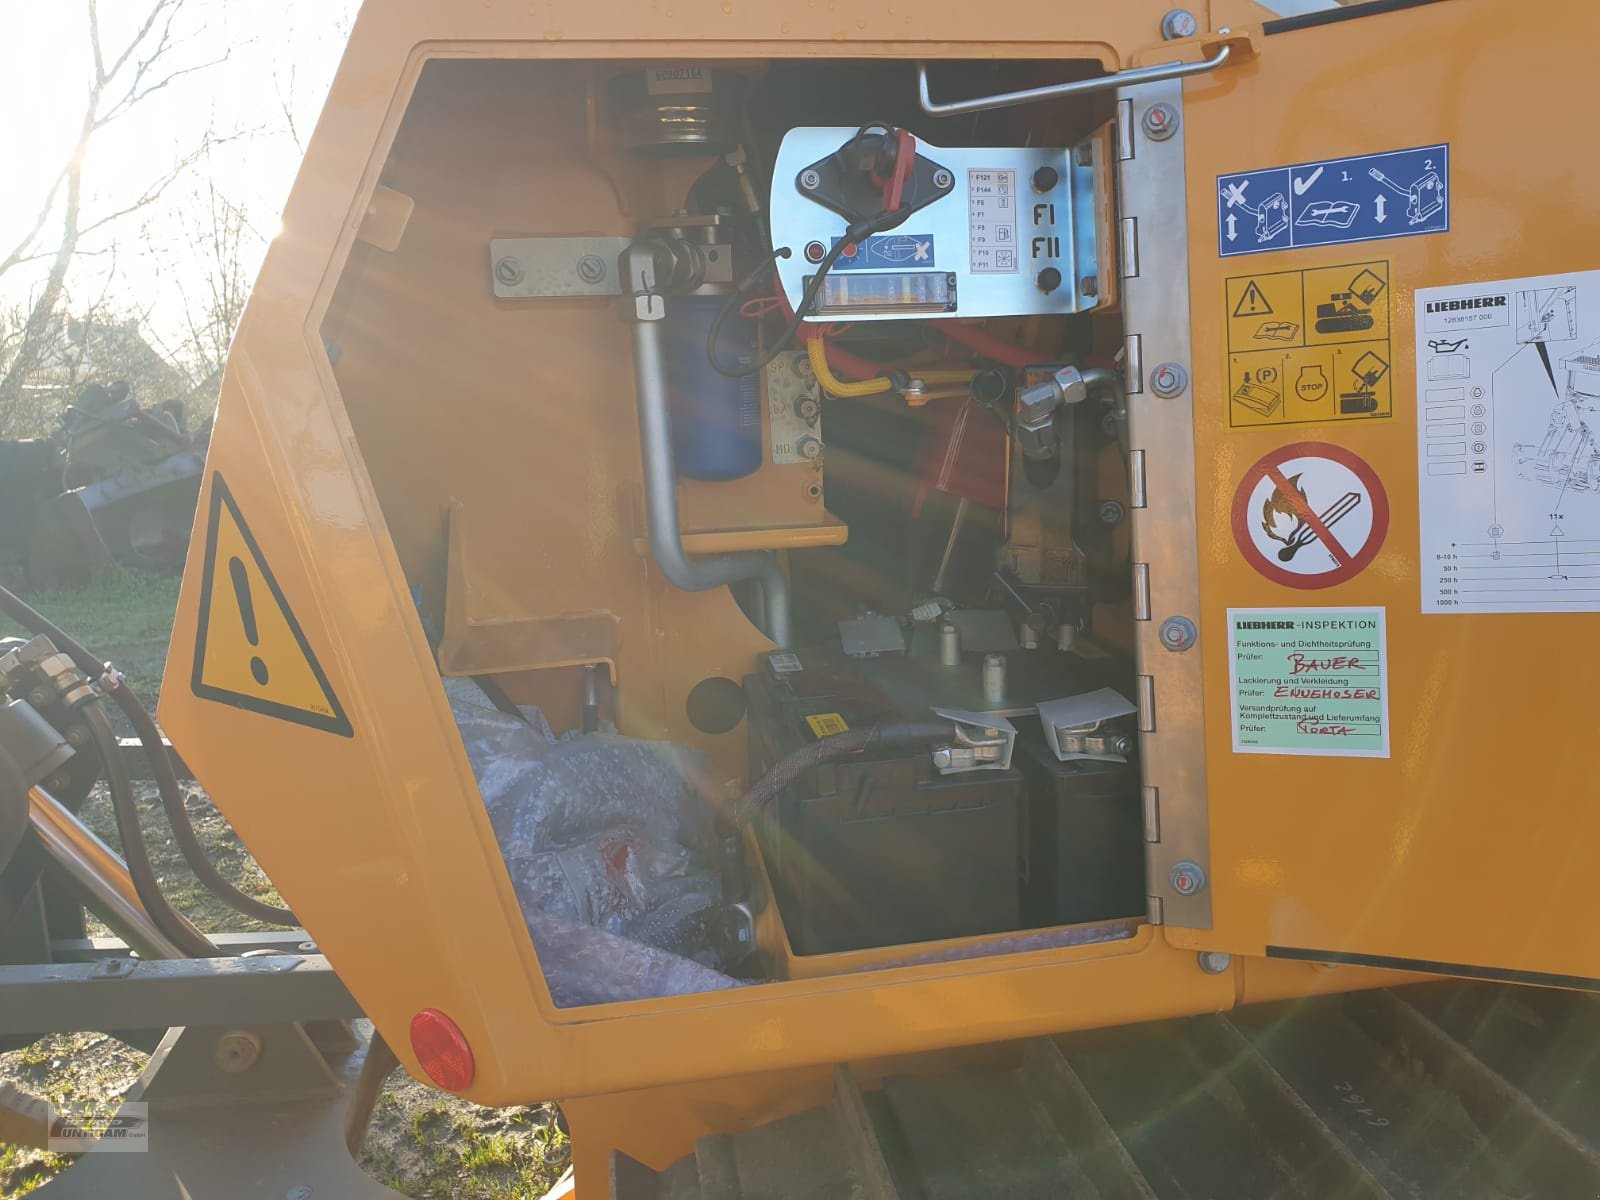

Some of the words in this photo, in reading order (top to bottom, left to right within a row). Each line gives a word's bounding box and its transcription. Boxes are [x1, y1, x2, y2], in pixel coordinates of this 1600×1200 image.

[1424, 159, 1436, 170] 2.
[1341, 170, 1352, 182] 1.
[1426, 296, 1506, 313] LIEBHERR
[1236, 620, 1294, 630] LIEBHERR
[1298, 640, 1371, 649] Dichtheitsprüfung
[1237, 652, 1263, 660] Prüfer:
[1287, 654, 1366, 675] BAUER
[1238, 677, 1282, 686] Lackierung
[1301, 678, 1348, 686] Verkleidung
[1240, 704, 1302, 713] Versandprüfung
[1240, 712, 1306, 721] Komplettzustand
[1326, 714, 1380, 723] Lieferumfang
[1240, 724, 1266, 732] Prüfer:
